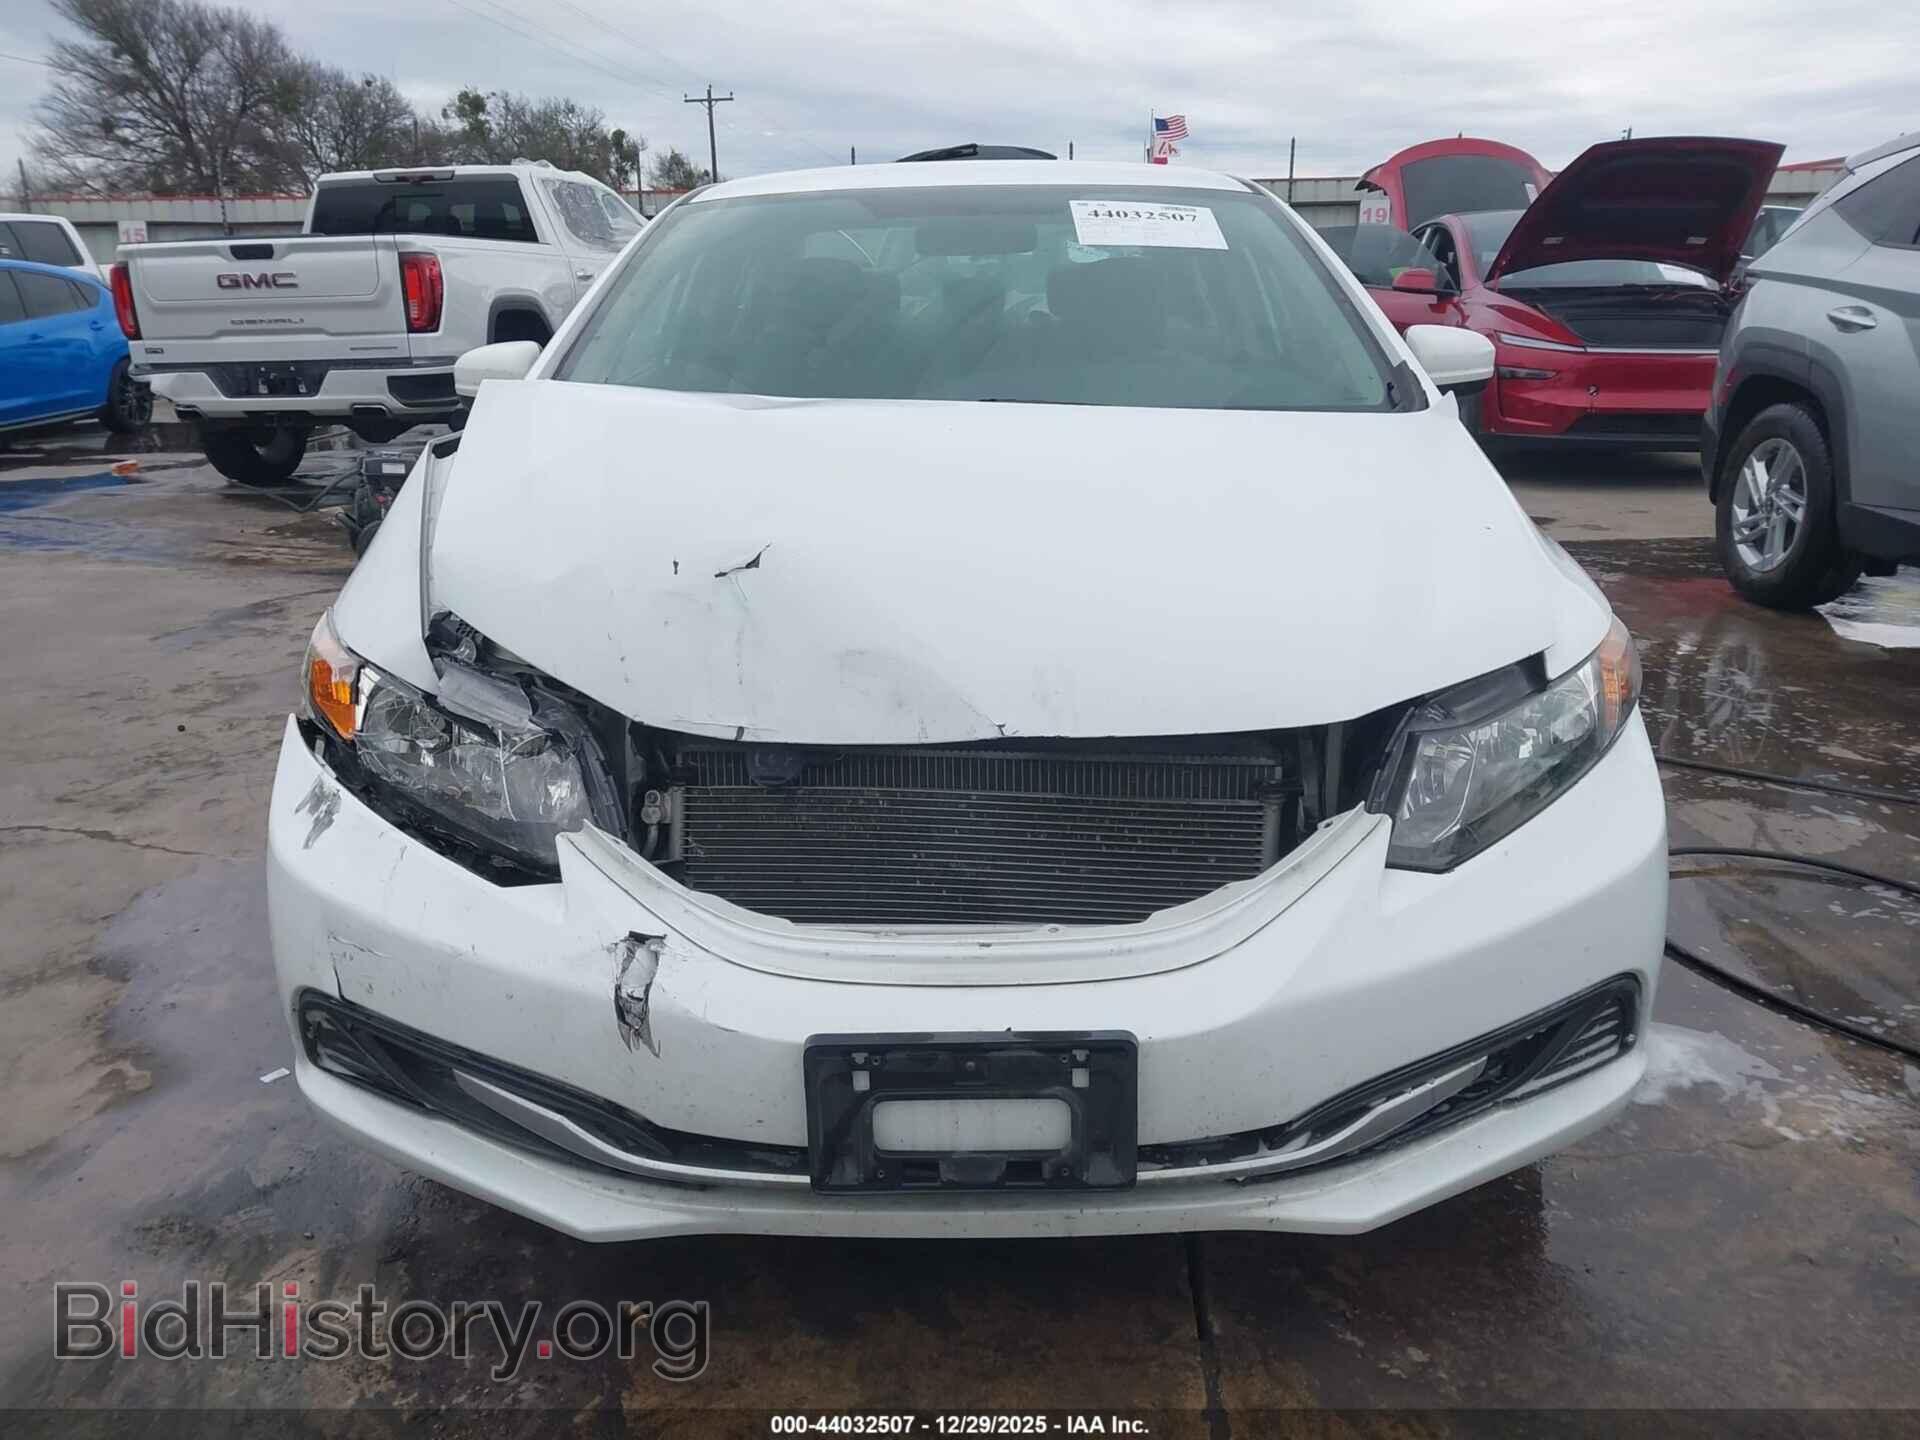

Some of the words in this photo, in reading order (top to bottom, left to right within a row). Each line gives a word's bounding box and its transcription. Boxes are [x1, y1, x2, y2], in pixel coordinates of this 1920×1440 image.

[1087, 208, 1198, 223] 44032507
[1362, 207, 1388, 224] 19
[216, 272, 298, 289] GMC
